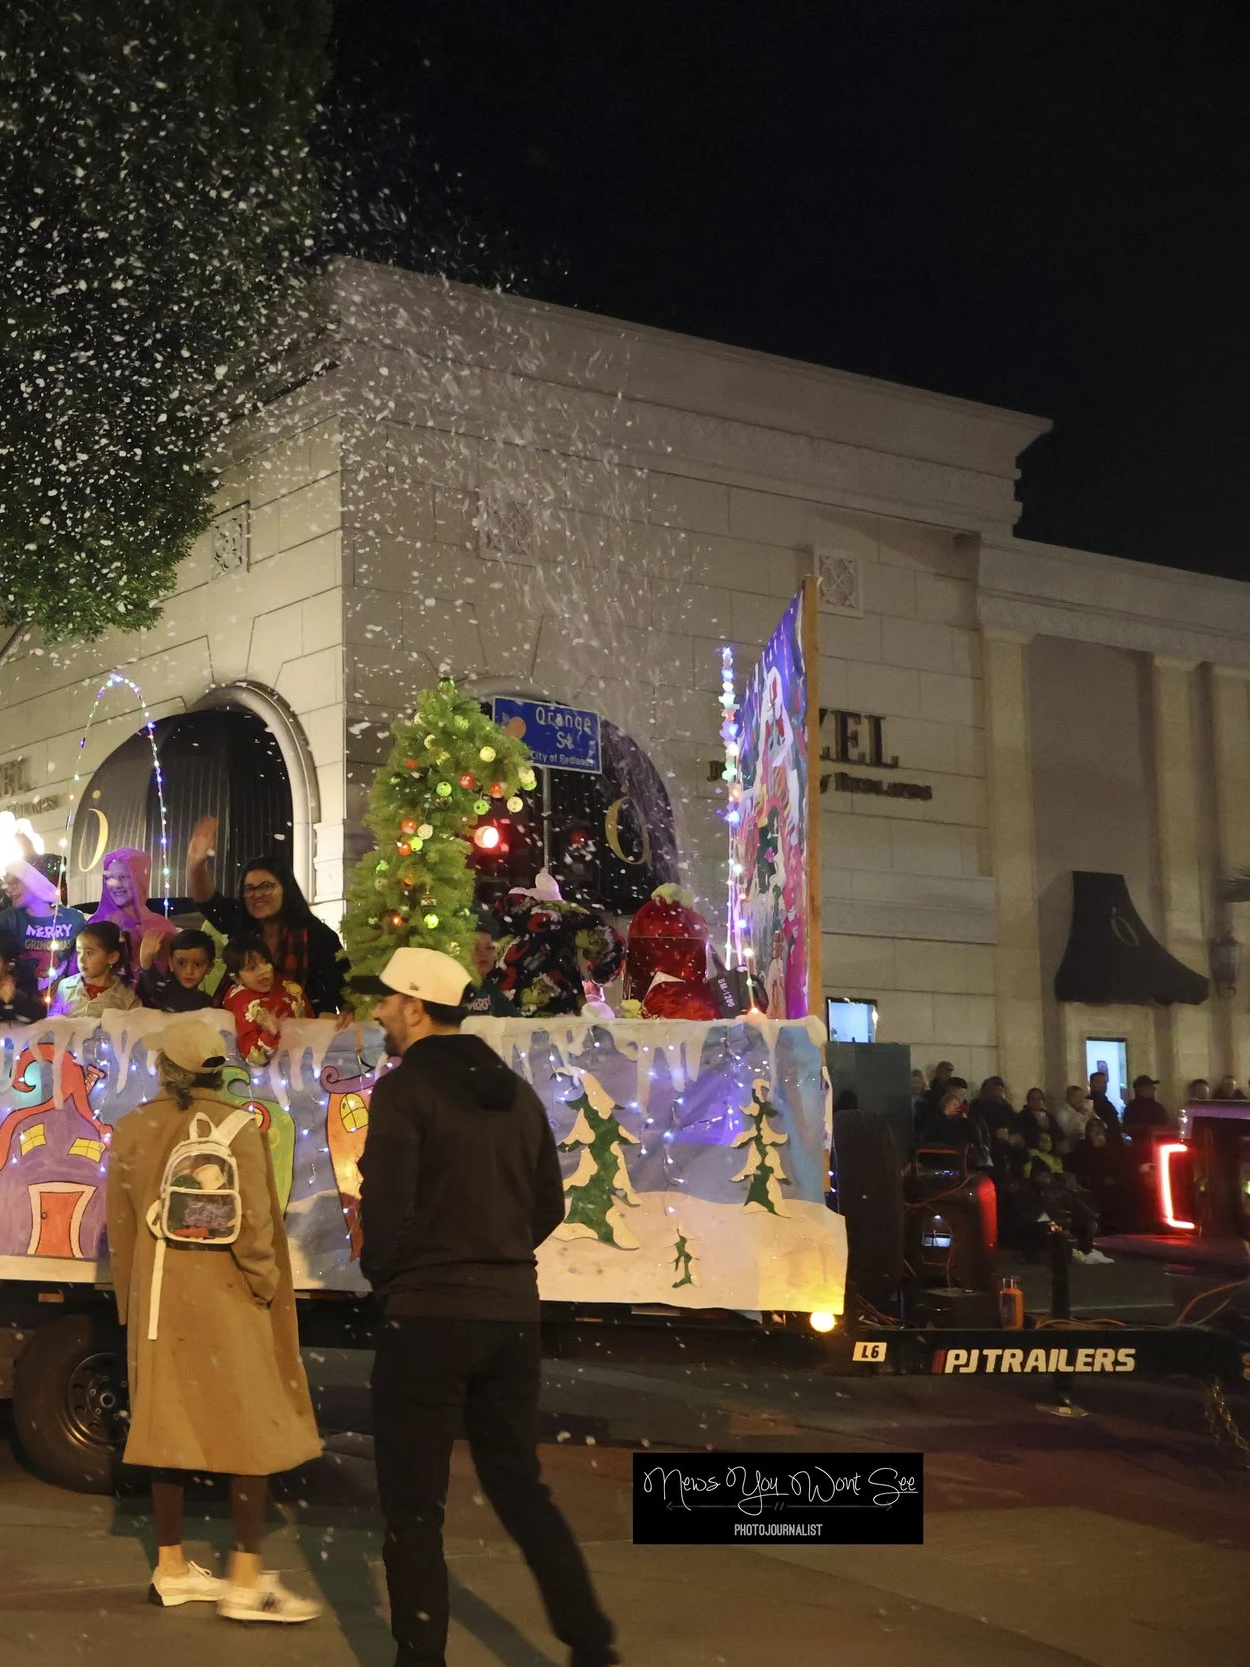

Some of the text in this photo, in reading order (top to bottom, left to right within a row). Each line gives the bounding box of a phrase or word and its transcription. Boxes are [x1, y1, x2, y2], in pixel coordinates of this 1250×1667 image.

[536, 706, 592, 734] Orange
[556, 731, 575, 750] St
[549, 753, 558, 761] of
[26, 923, 73, 939] MERRY
[861, 1345, 880, 1359] L6
[981, 1348, 1136, 1373] TRAILERS
